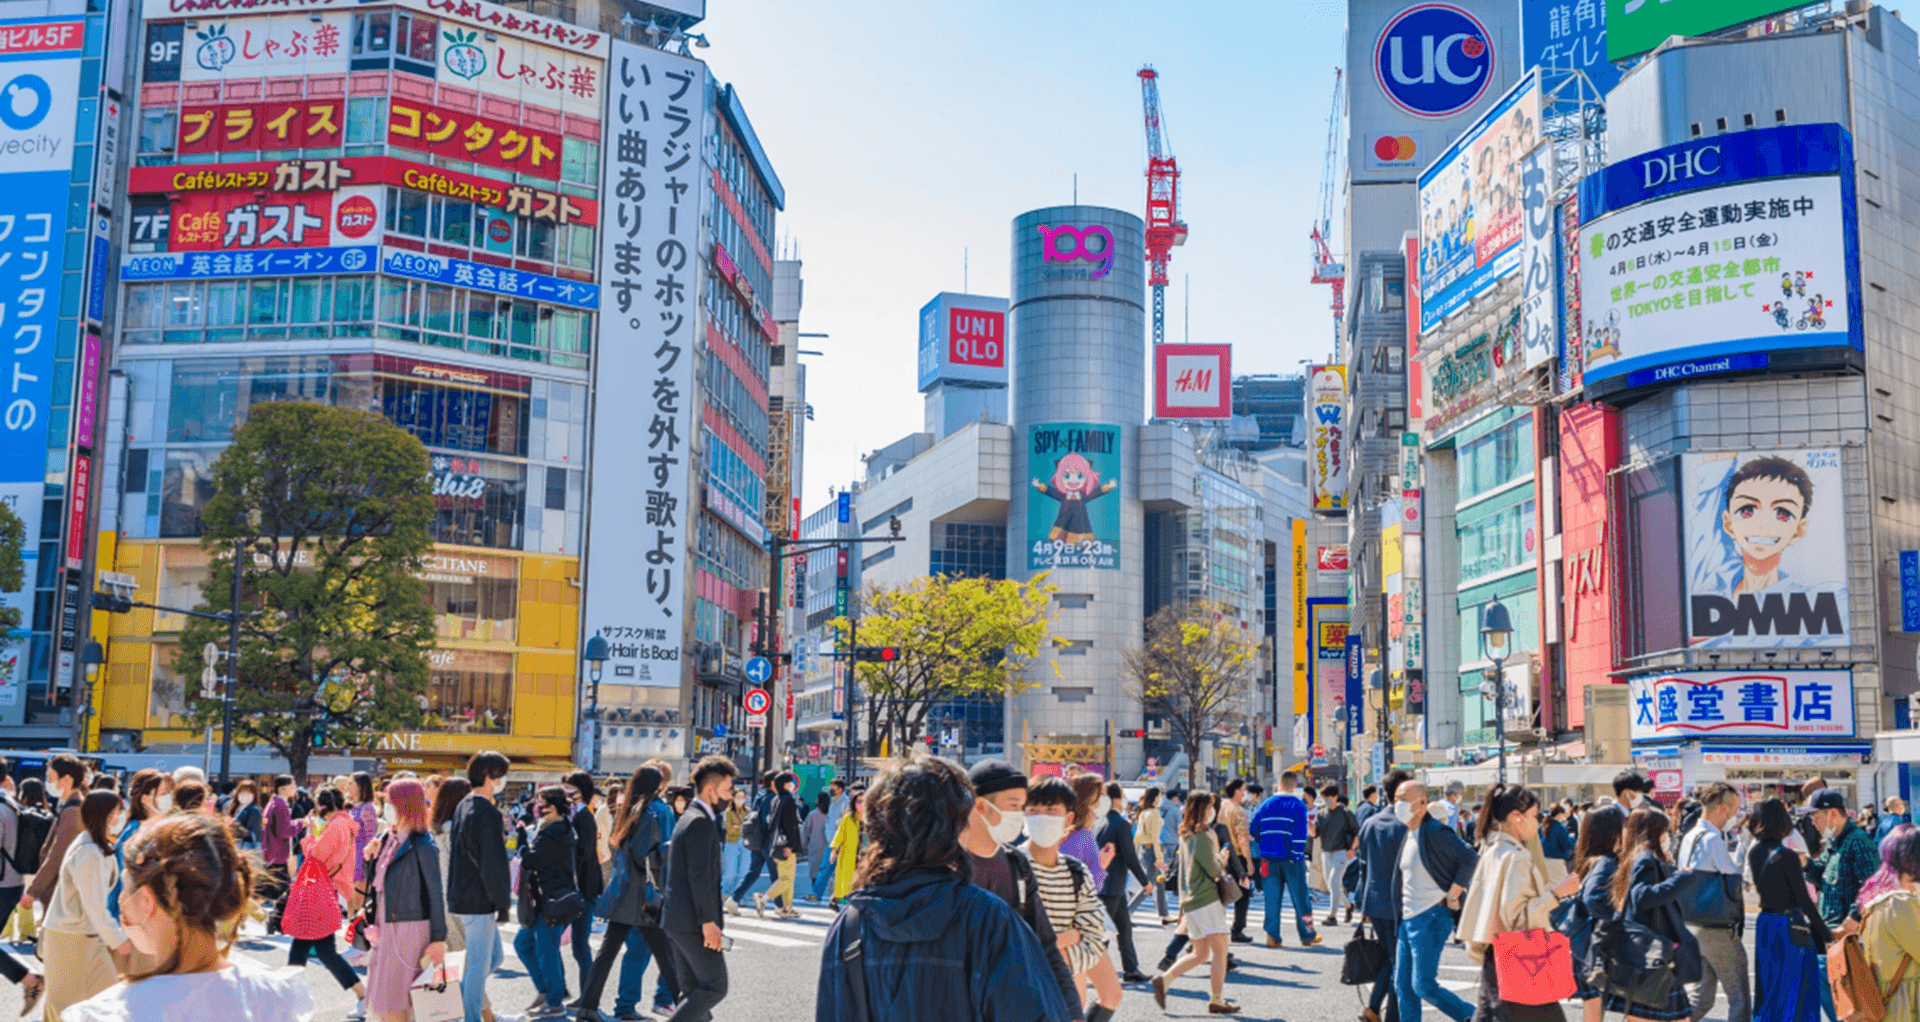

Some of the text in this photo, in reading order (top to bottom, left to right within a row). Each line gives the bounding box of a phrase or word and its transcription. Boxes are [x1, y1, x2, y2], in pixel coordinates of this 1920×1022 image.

[149, 41, 180, 62] 9F
[242, 23, 340, 60] しゃぶ葉
[496, 46, 597, 98] しゃぶ葉
[182, 104, 338, 143] プライス
[390, 104, 556, 166] コンタクト
[273, 160, 351, 192] ガスト
[1642, 145, 1721, 188] DHC
[506, 186, 582, 224] ガスト
[611, 57, 651, 330] いい曲あります。
[133, 215, 170, 240] 7F
[178, 211, 220, 231] Café
[223, 204, 322, 247] ガスト
[340, 214, 373, 227] ガスト
[1589, 195, 1815, 259] 春の交通安全運動実施中
[131, 258, 174, 273] AEON
[191, 252, 333, 276] 英会話イーオン
[1037, 224, 1115, 280] 109
[1521, 152, 1551, 354] もんじゃ
[391, 253, 595, 303] AEON 英会話イーオン
[1610, 256, 1781, 303] 世界一の交通安全都市
[5, 213, 52, 431] コンタクトの
[956, 315, 994, 337] UNI
[645, 69, 695, 618] ブラジャーのホックを外す歌より、
[956, 338, 998, 361] QLO
[1174, 368, 1213, 393] H&M
[1655, 358, 1730, 380] DHC Channel
[602, 626, 667, 641] サブスク解禁
[1690, 592, 1844, 636] DMM
[640, 643, 650, 659] is
[651, 646, 679, 661] Bad
[1635, 681, 1833, 726] 大盛堂書店
